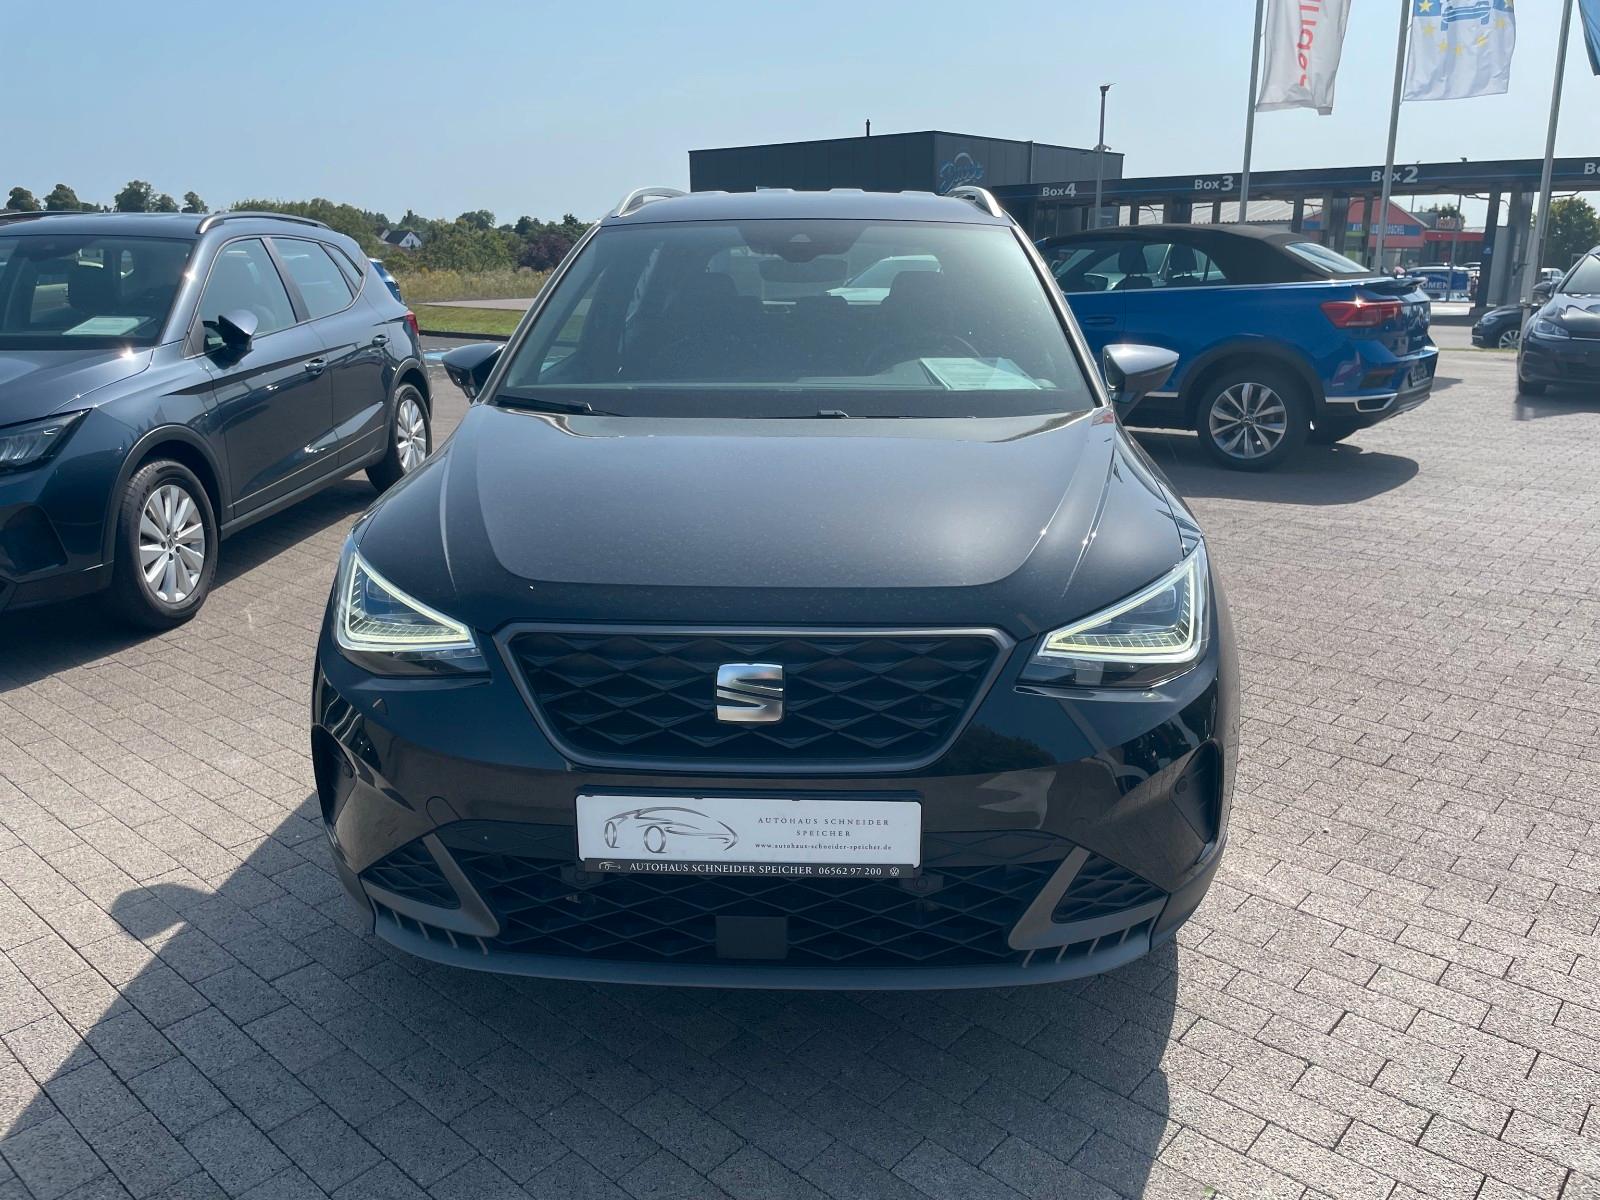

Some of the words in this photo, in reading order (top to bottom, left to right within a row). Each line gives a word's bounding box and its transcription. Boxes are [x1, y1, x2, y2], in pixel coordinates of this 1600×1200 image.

[758, 817, 818, 825] AUTOHAUS
[824, 818, 889, 826] SCHNEIDER
[796, 829, 851, 837] SPEICHER
[755, 843, 892, 851] www.autohaus-schneider-speicher.de
[629, 862, 688, 872] AUTOHAUS
[691, 863, 755, 874] SCHNEIDER
[759, 865, 812, 875] SPEICHER
[818, 866, 848, 875] 06562
[850, 867, 862, 875] 97
[864, 867, 882, 876] 200
